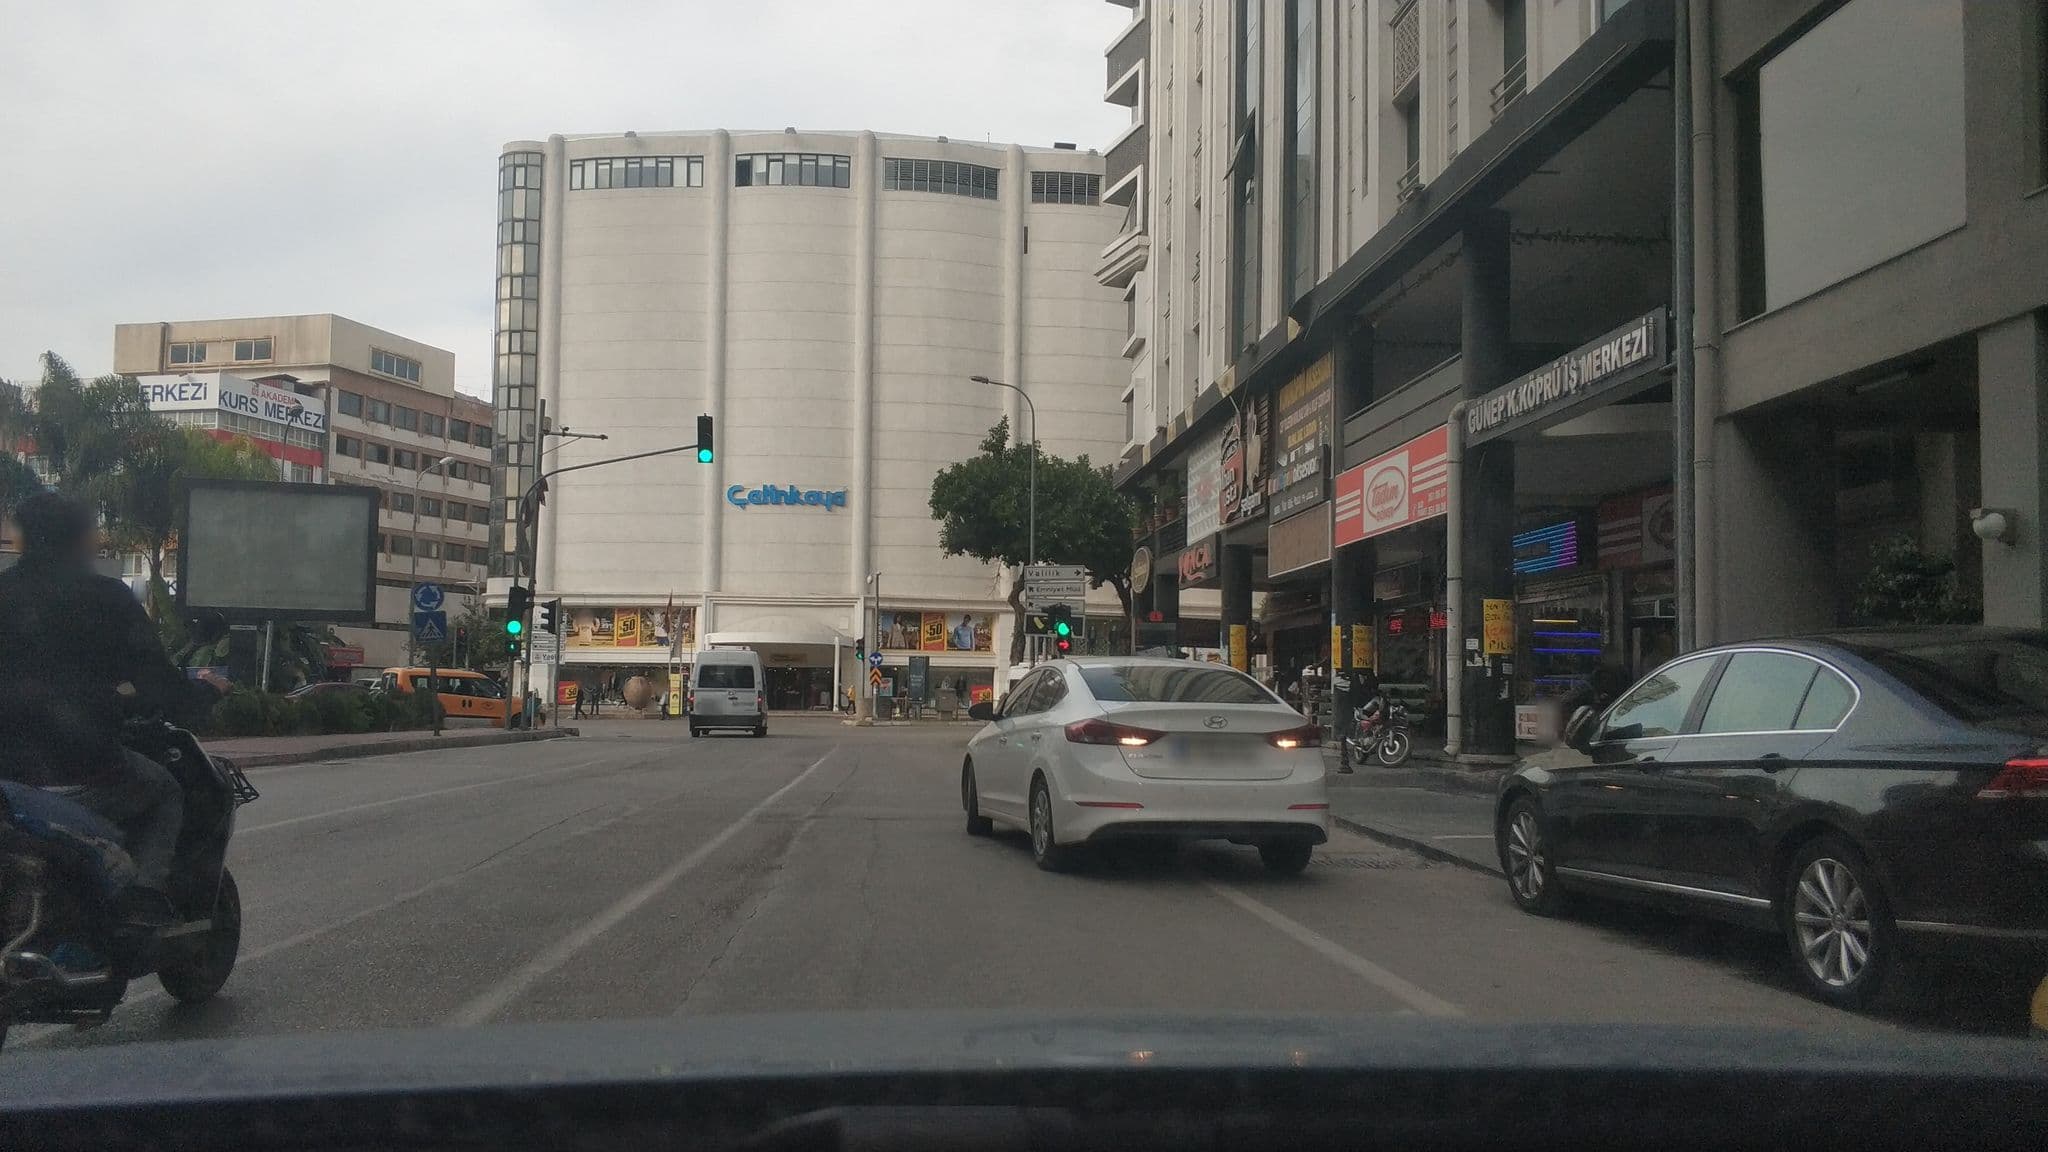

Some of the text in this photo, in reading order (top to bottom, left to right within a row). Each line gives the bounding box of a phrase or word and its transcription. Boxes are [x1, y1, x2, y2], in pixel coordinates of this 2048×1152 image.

[1468, 397, 1505, 434] GÜNEP
[1562, 356, 1578, 394] İŞ
[1579, 318, 1649, 385] MERKEZİ
[219, 390, 258, 414] KURS
[261, 390, 297, 405] AKADEM
[727, 485, 846, 512] Çetinkaya
[1028, 569, 1060, 577] Valilik
